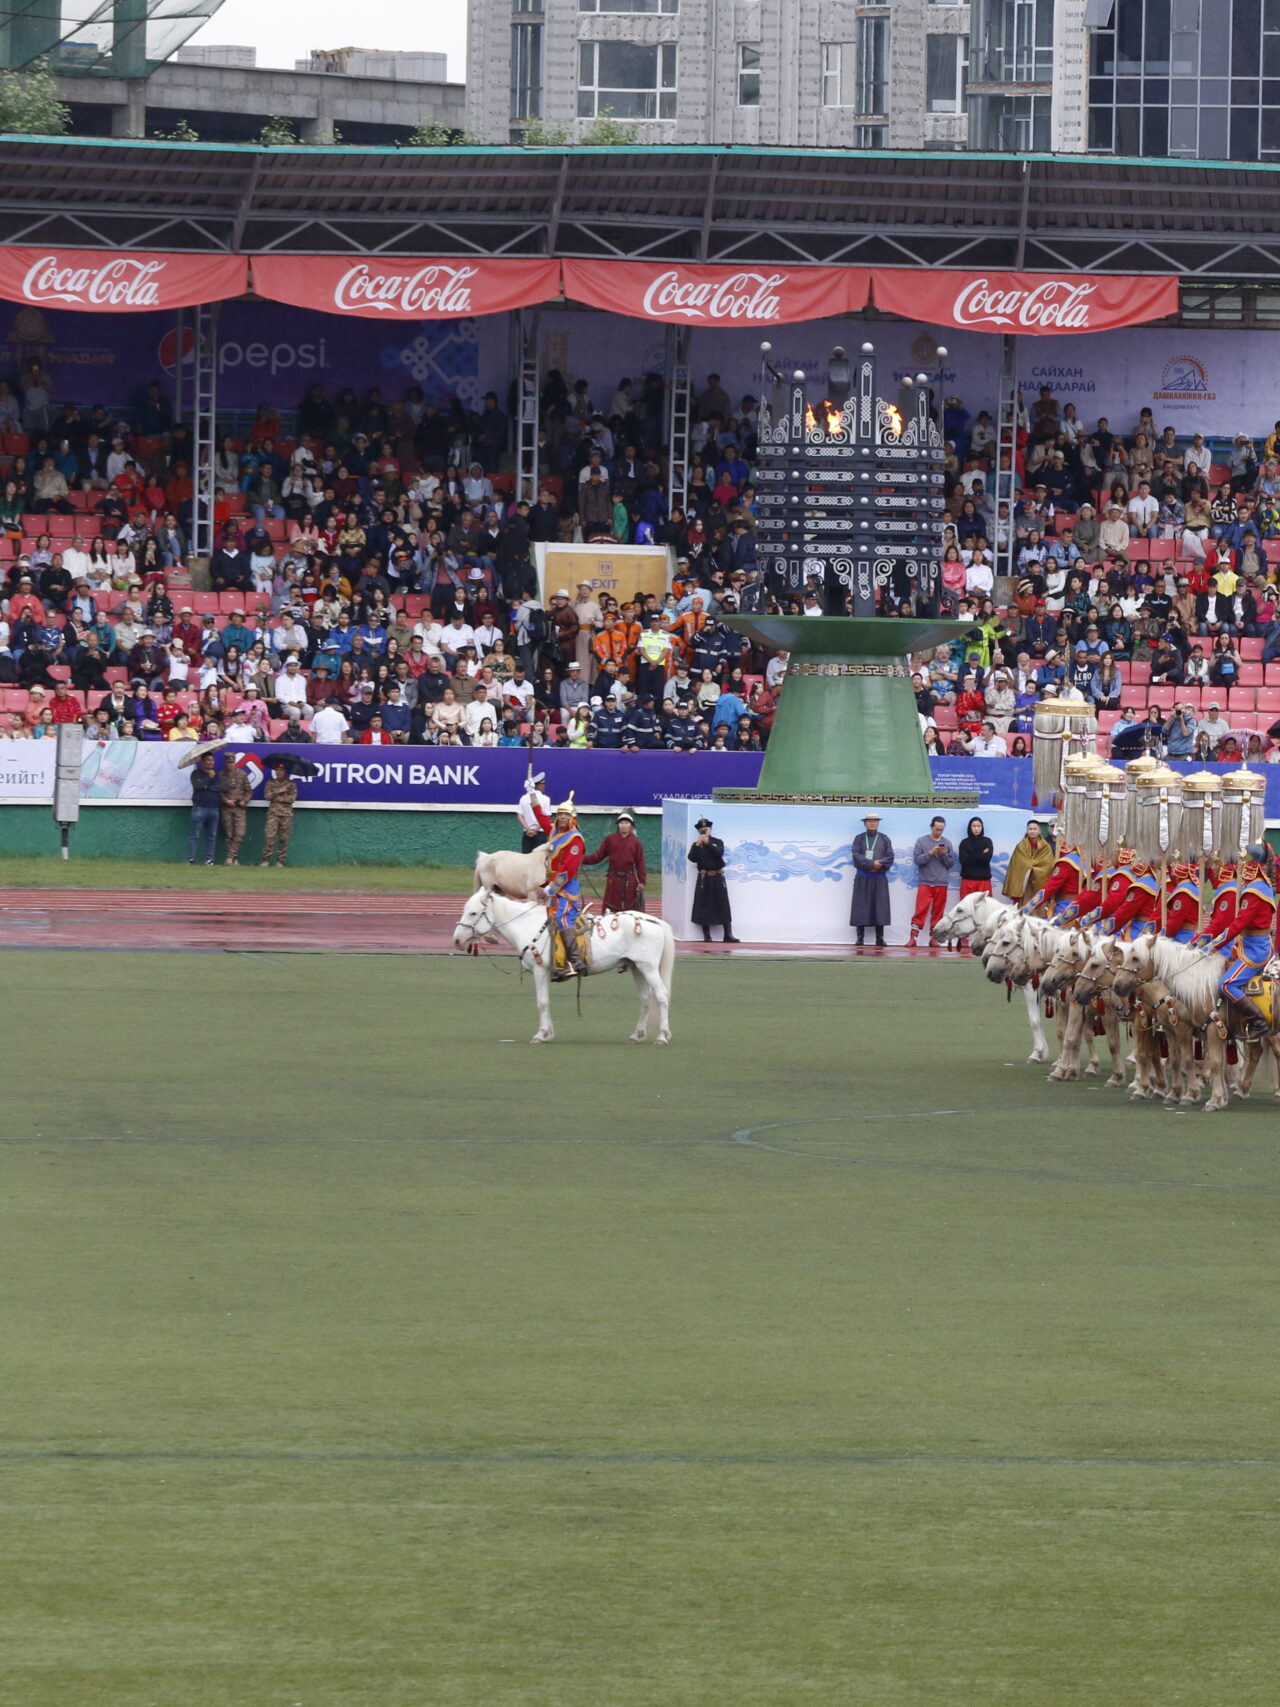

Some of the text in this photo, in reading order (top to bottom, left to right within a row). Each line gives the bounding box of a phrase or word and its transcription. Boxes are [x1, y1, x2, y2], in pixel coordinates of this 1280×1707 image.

[23, 256, 167, 305] Coca-Cola
[335, 264, 479, 312] Coca-Cola
[643, 271, 788, 319] Coca-Cola
[953, 278, 1099, 328] Coca-Cola
[219, 338, 326, 375] pepsi
[1031, 365, 1083, 377] САЙХАН
[592, 578, 619, 590] EXIT
[410, 765, 481, 786] BANK
